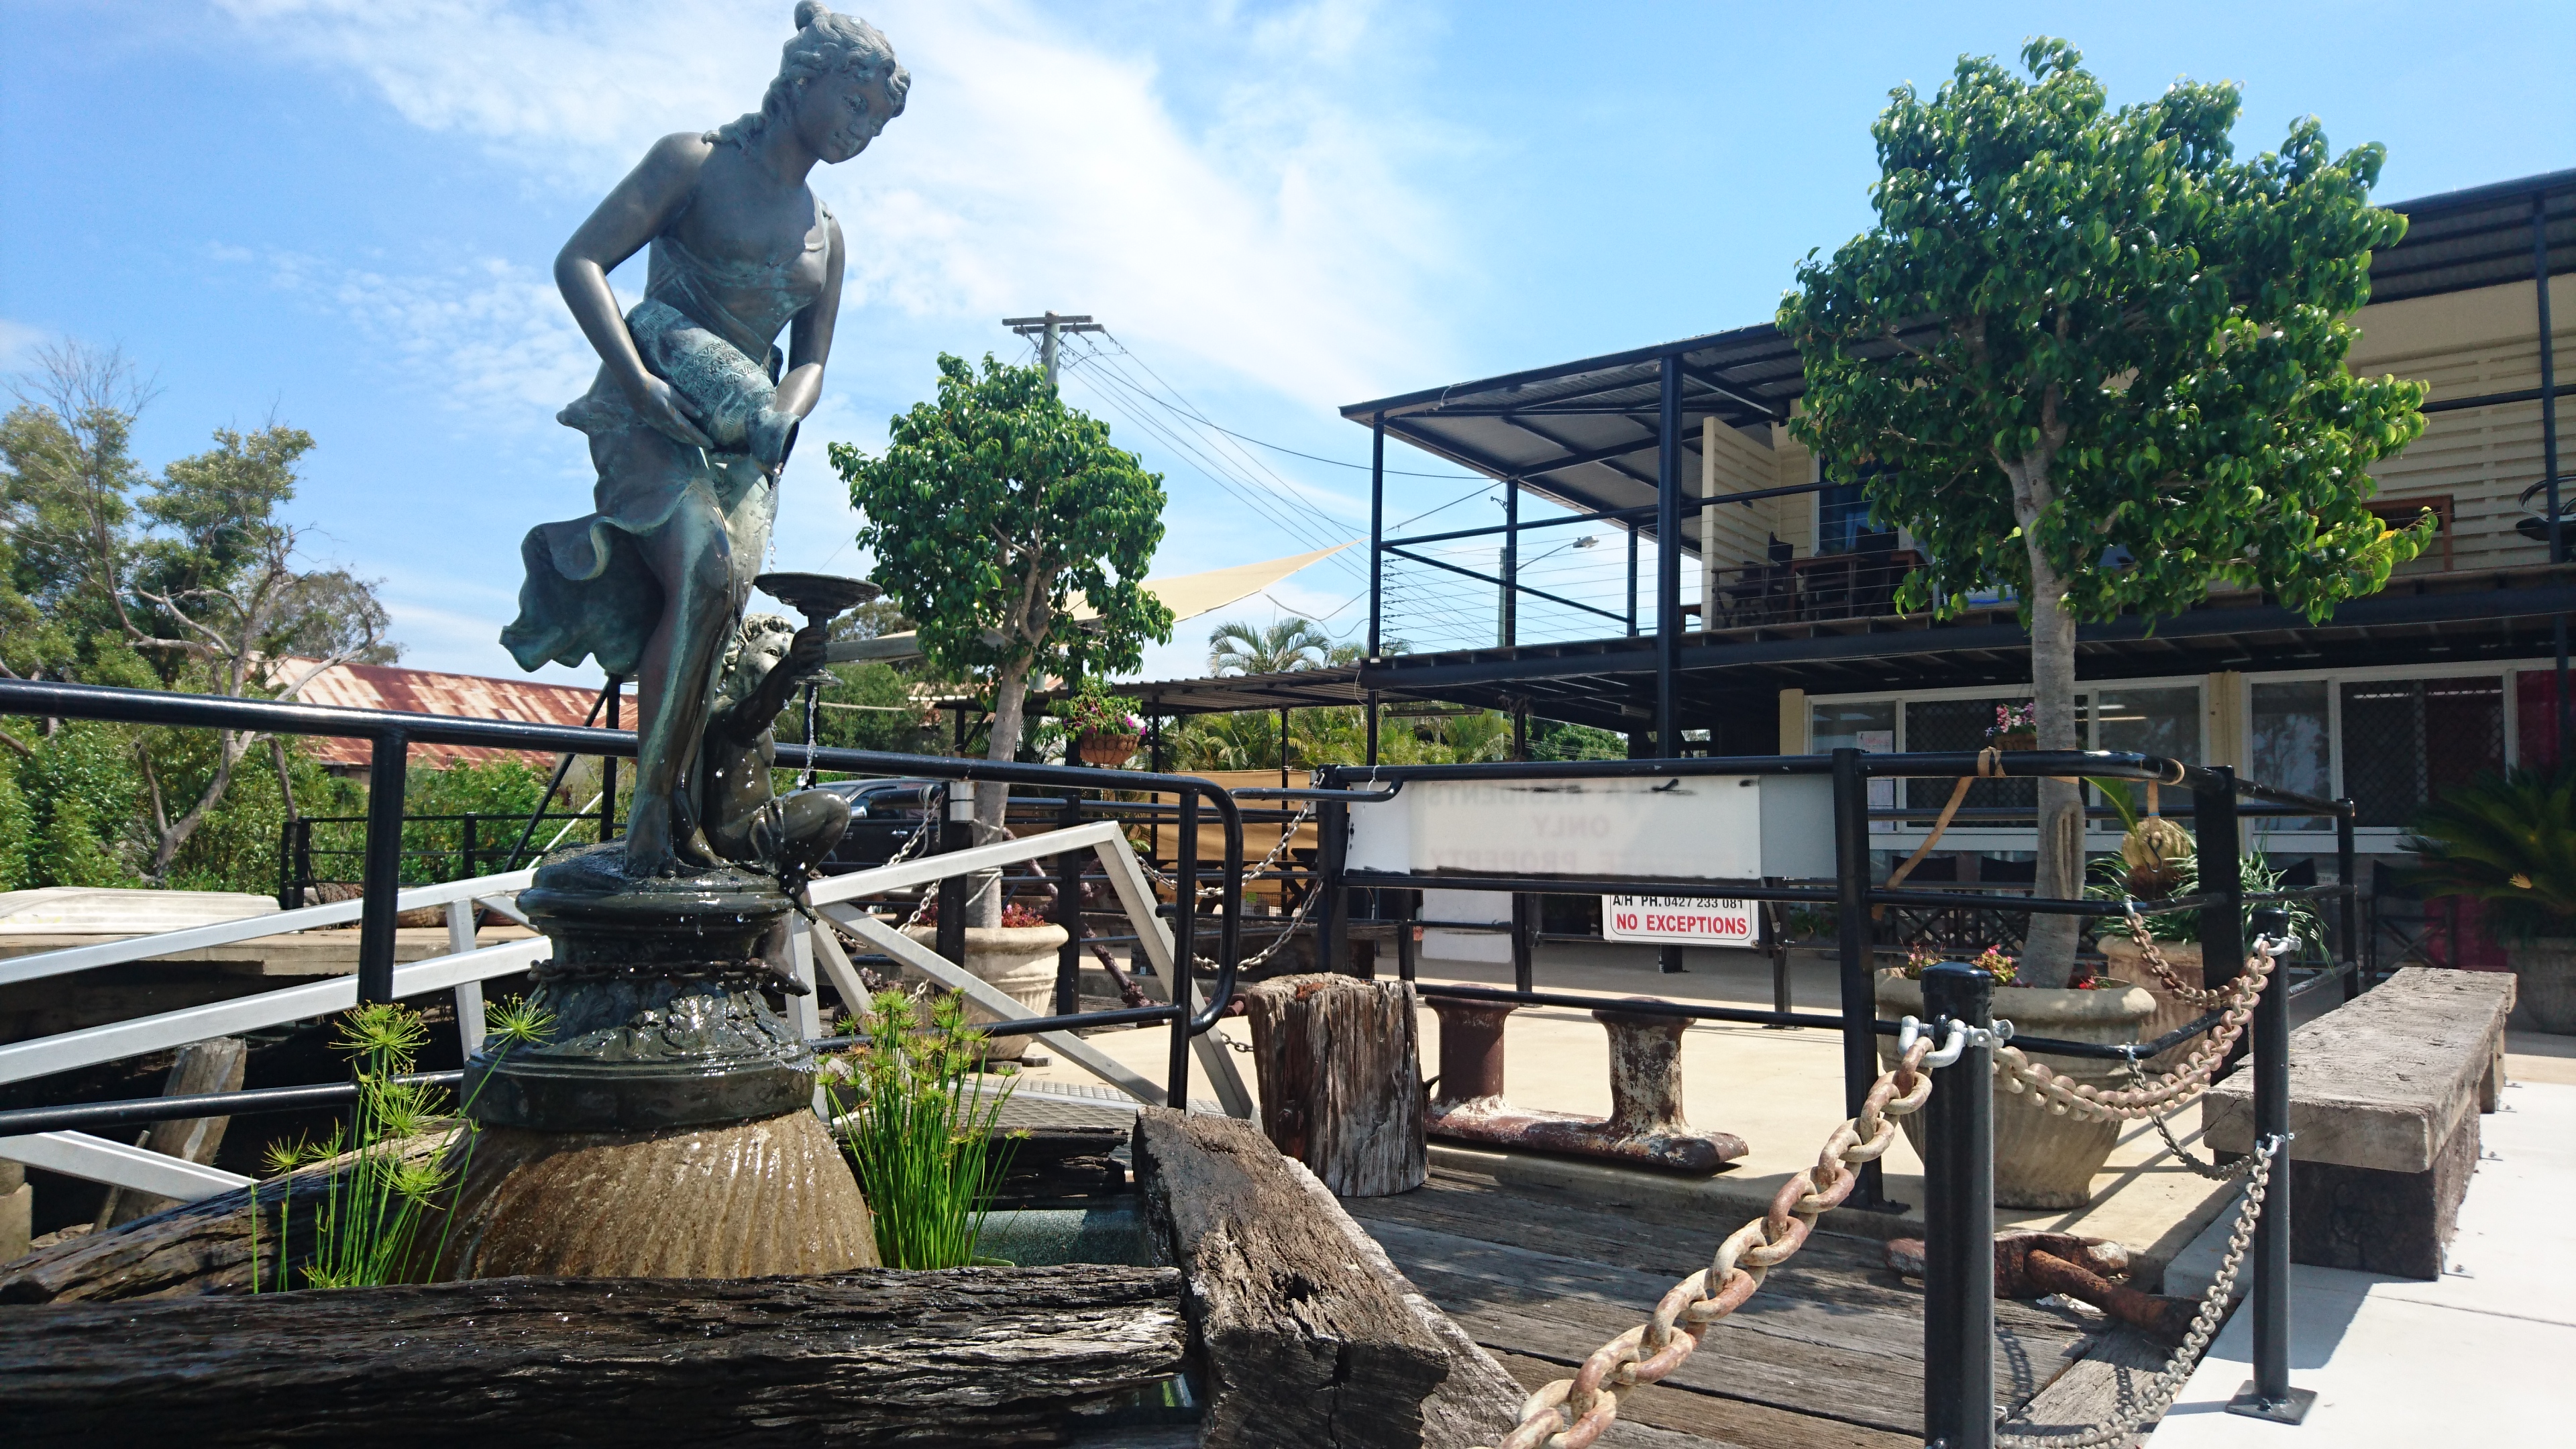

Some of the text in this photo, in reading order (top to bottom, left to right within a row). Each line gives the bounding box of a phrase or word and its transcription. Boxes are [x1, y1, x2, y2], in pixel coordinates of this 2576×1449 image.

[1613, 895, 1743, 909] A/H PH. 0427 233 081
[1616, 913, 1747, 935] NO EXCEPTIONS
